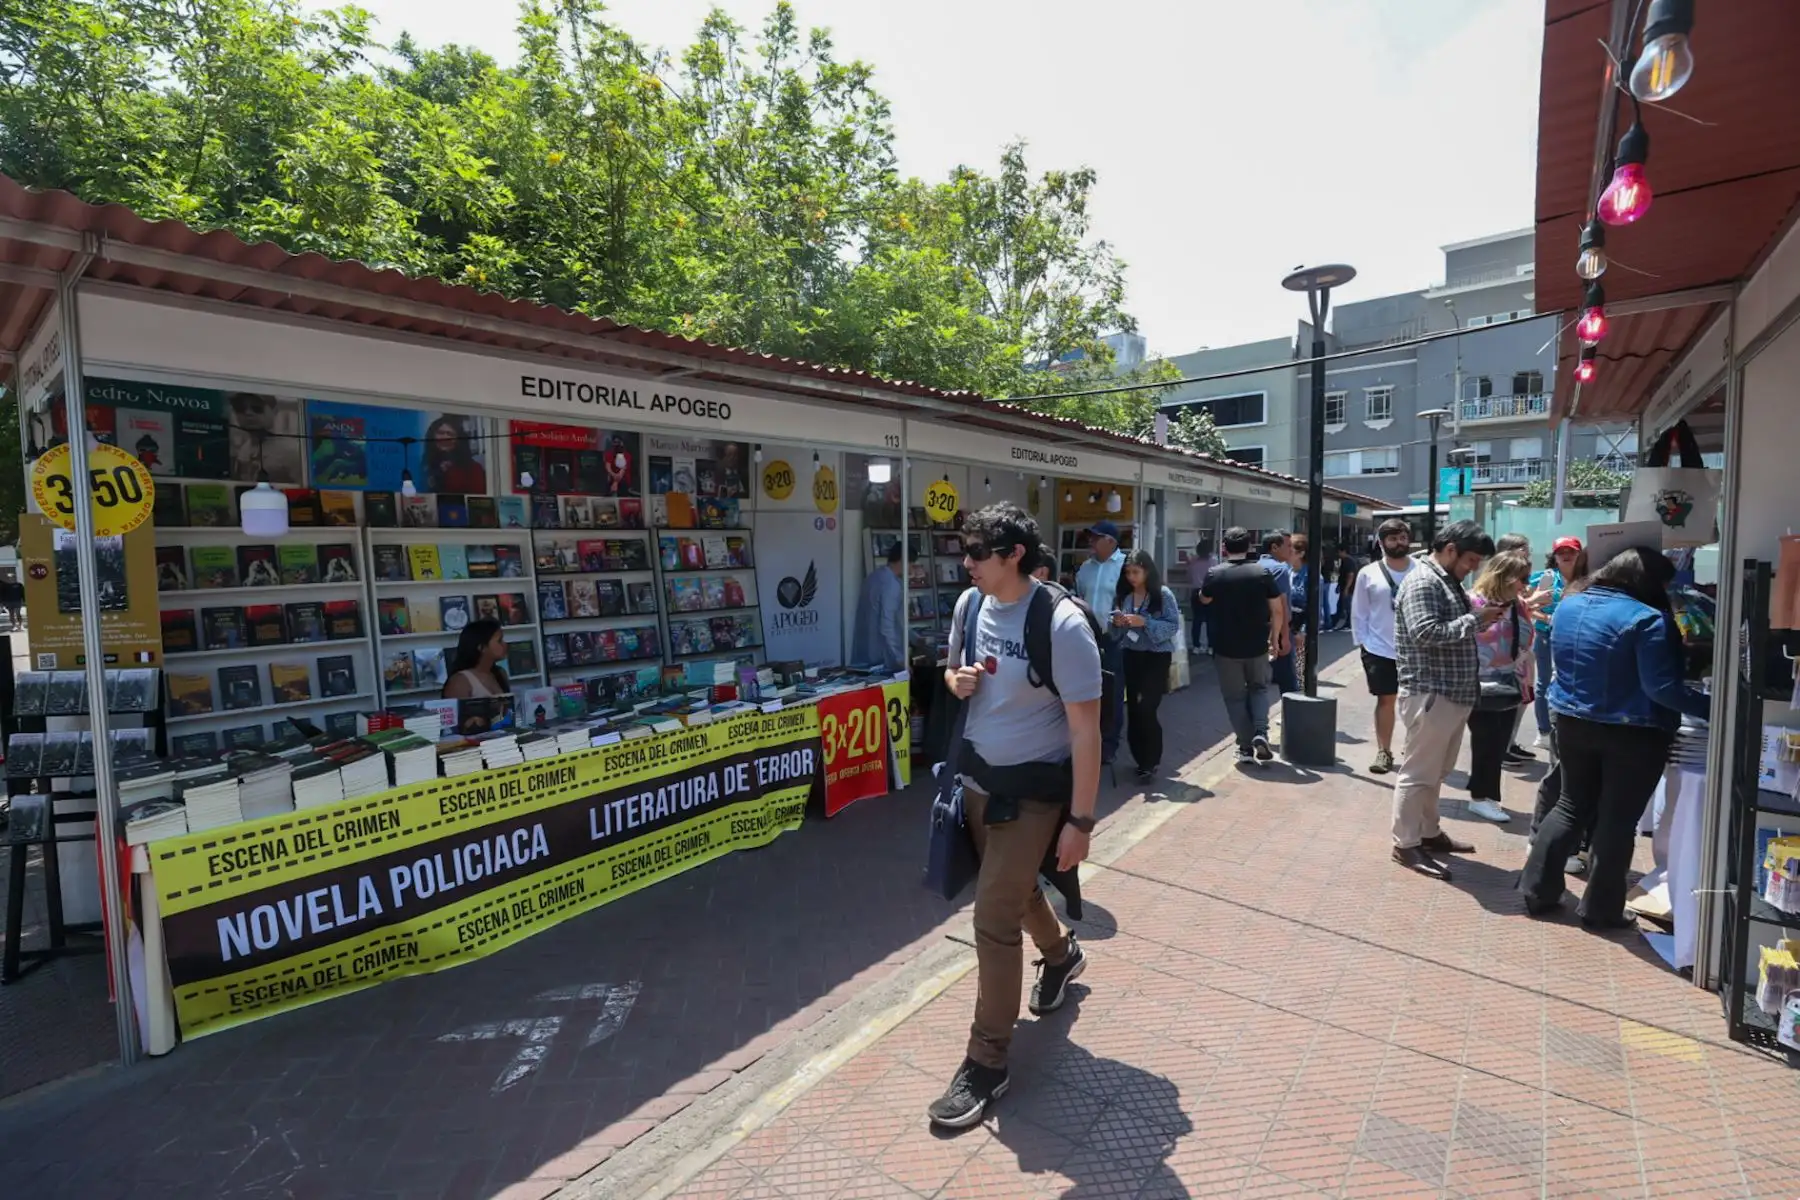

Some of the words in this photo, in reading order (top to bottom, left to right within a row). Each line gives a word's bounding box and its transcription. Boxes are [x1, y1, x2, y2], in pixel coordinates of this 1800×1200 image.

[89, 384, 140, 402] edro
[147, 388, 211, 411] Novoa
[521, 375, 645, 410] EDITORIAL
[650, 396, 732, 421] APOGEO
[884, 434, 900, 448] 113
[1011, 447, 1049, 464] EDITORIAL
[1049, 454, 1078, 468] APOGEO
[46, 465, 143, 514] 350
[766, 472, 791, 491] 3x20
[928, 490, 955, 512] 3x20
[771, 609, 819, 630] APOGEO
[823, 705, 881, 765] 3x20
[208, 837, 288, 877] ESCENA
[293, 826, 329, 853] DEL
[333, 809, 401, 842] CRIMEN
[439, 786, 496, 816] ESCENA
[500, 778, 525, 803] DEL
[528, 765, 576, 795] CRIMEN
[604, 749, 646, 772] ESCENA
[648, 744, 668, 763] DEL
[670, 733, 708, 759] CRIMEN
[762, 717, 776, 733] DEL
[778, 712, 805, 729] CRIMEN
[216, 875, 383, 962] NOVELA
[389, 823, 549, 908] POLICIACA
[590, 773, 719, 841] LITERATURA
[723, 762, 750, 796] DE
[229, 975, 307, 1007] ESCENA
[313, 963, 348, 987] DEL
[352, 941, 419, 974] CRIMEN
[458, 911, 509, 944] ESCENA
[512, 901, 535, 921] DEL
[539, 878, 585, 908] CRIMEN
[611, 857, 651, 881] ESCENA
[654, 849, 673, 869] DEL
[675, 831, 711, 859] CRIMEN
